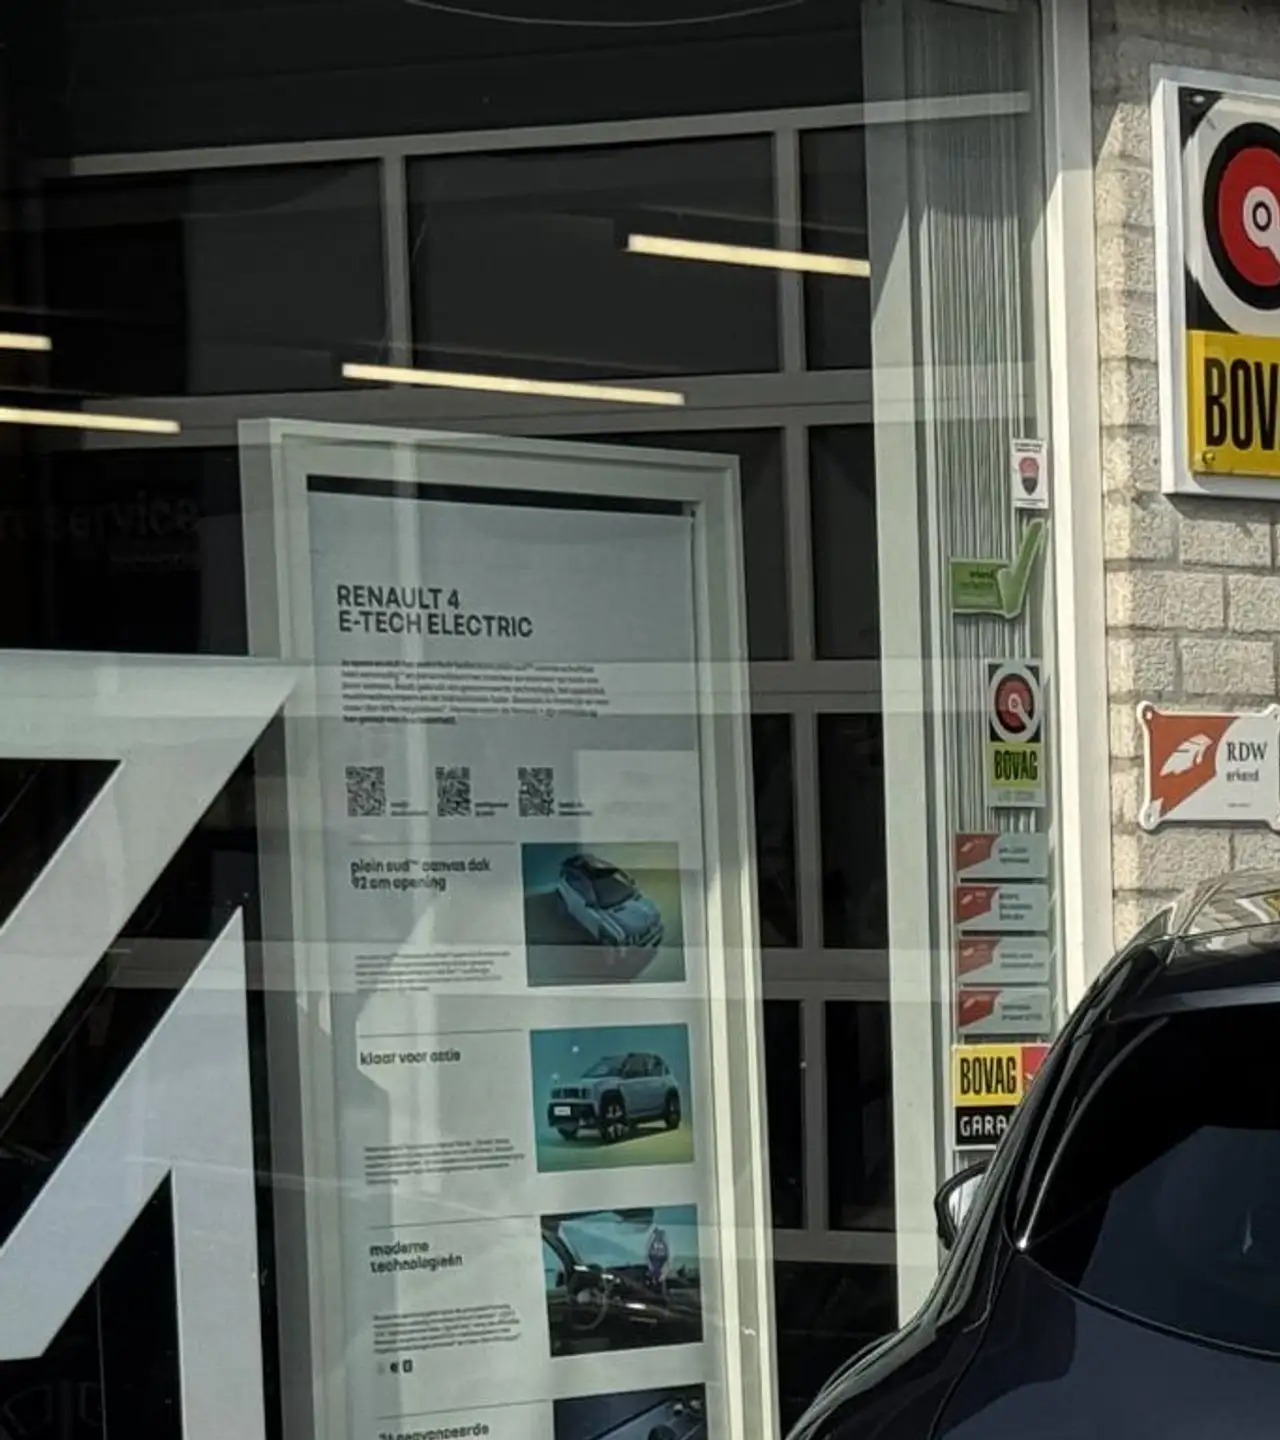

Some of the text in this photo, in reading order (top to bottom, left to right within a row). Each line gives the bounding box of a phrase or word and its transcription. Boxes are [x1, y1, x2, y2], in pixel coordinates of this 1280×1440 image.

[337, 585, 460, 609] RENAULT 4
[339, 610, 533, 637] E-TECH ELECTRIC
[1226, 741, 1268, 761] RDW
[994, 749, 1037, 781] BOVAG
[960, 1056, 1017, 1096] BOVAG
[961, 1115, 1010, 1137] GARA
